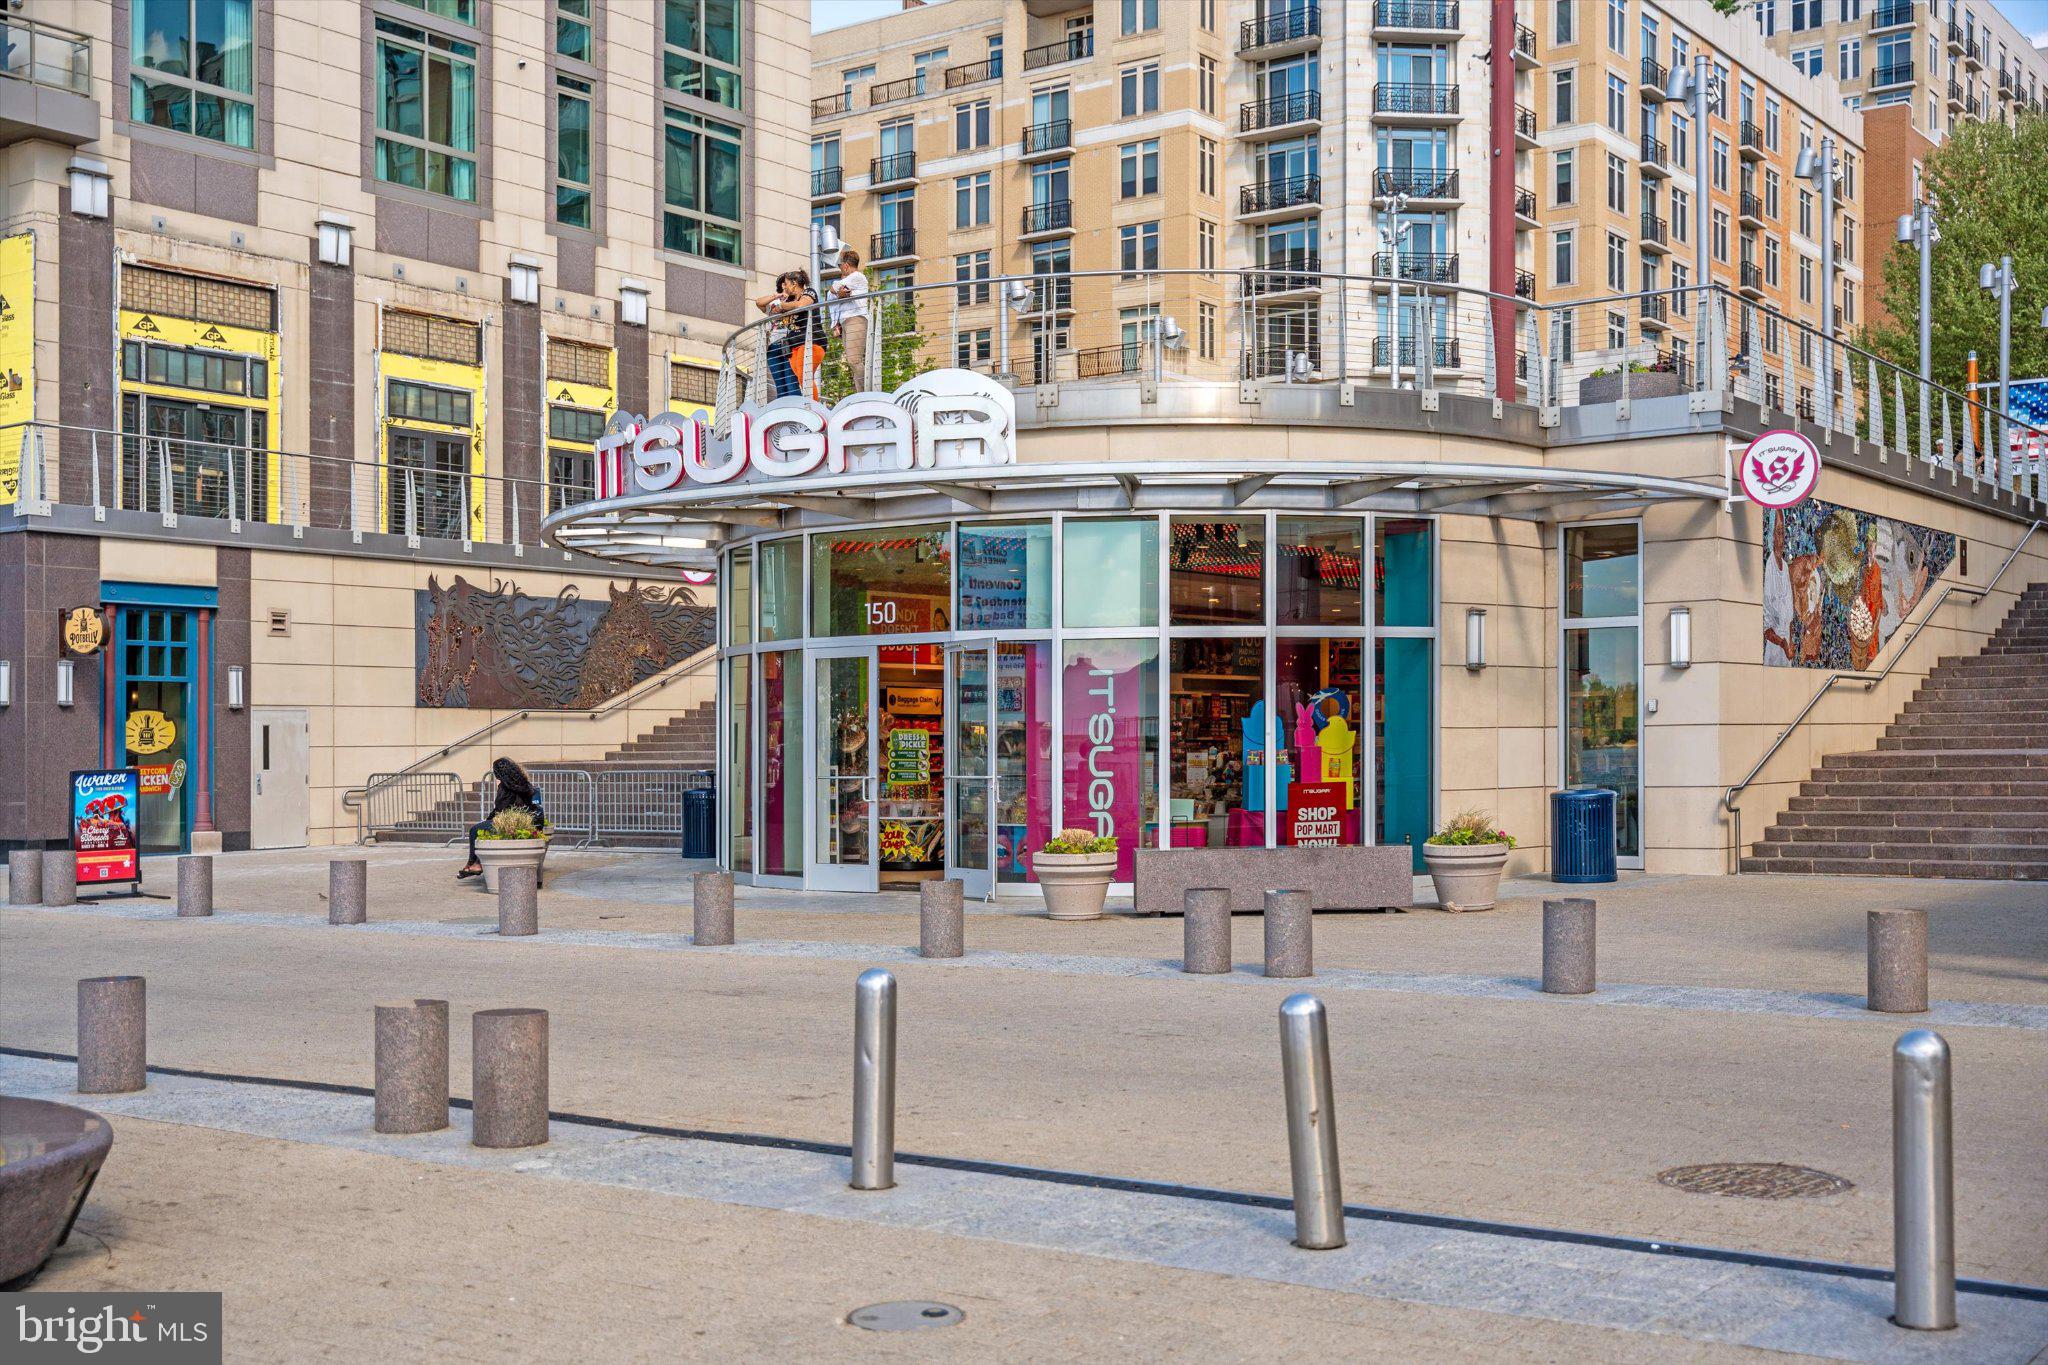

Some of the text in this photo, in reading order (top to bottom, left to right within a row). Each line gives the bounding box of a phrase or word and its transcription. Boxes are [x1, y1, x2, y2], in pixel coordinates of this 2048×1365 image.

[138, 321, 155, 331] GP
[205, 331, 221, 341] GP
[594, 394, 1010, 500] IT'SUGAR
[1759, 445, 1798, 457] IT'SUGAR
[864, 601, 896, 625] 150
[70, 630, 98, 645] POTBELLY
[897, 696, 919, 704] Baggage
[898, 733, 920, 741] DRESS
[899, 741, 926, 749] PICKLE
[1088, 669, 1116, 838] IT'SUGA
[75, 772, 128, 797] Awaken
[141, 774, 169, 786] ICKEN
[1297, 806, 1337, 821] SHOP
[1296, 824, 1338, 835] POP MART
